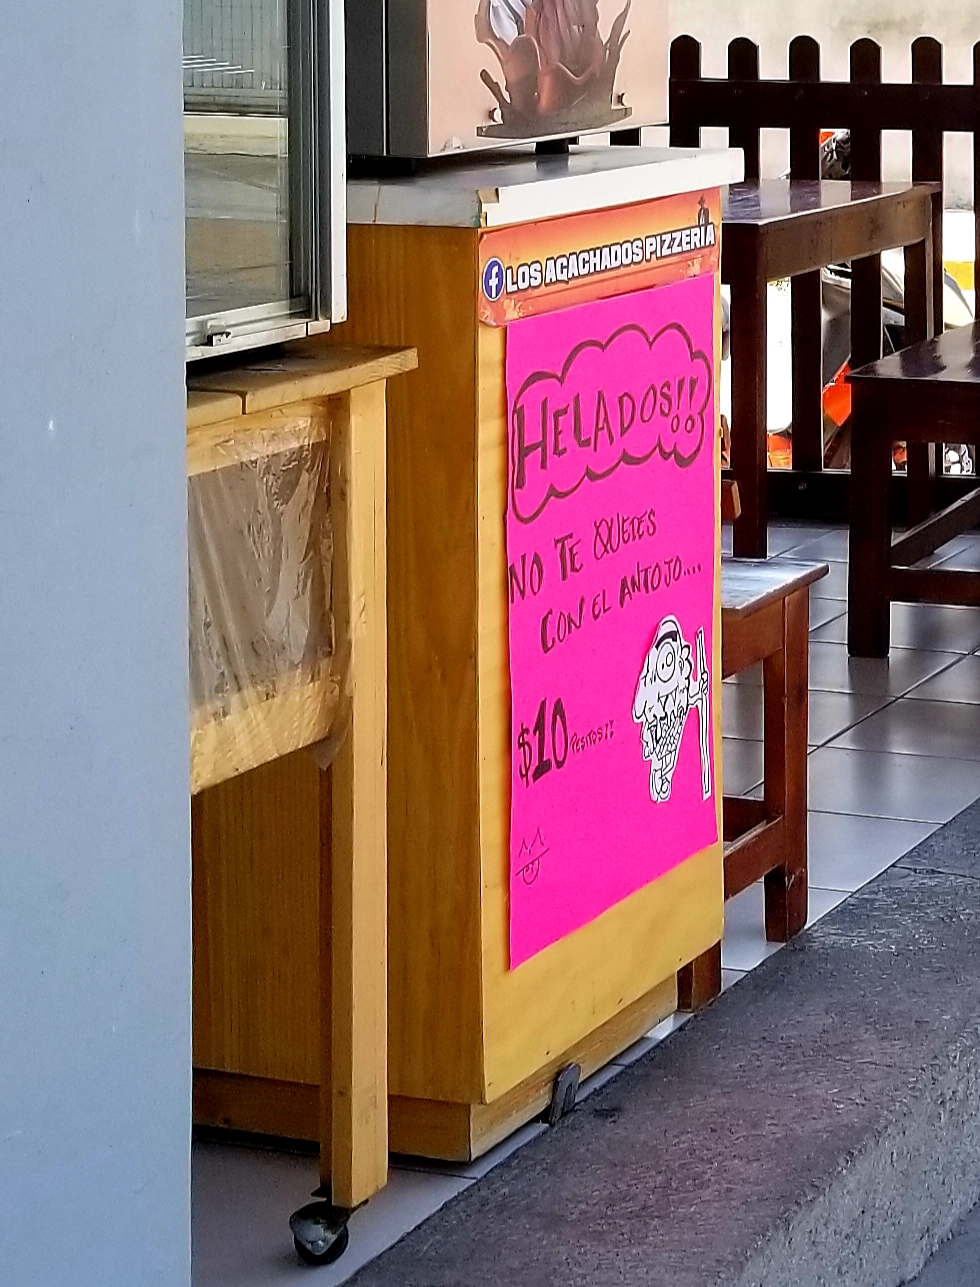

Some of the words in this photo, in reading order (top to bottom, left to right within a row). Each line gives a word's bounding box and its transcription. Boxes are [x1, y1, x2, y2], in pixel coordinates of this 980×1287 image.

[506, 264, 543, 295] LOS
[544, 239, 644, 284] AGACHADOS
[514, 376, 699, 491] HELADOS!!
[508, 551, 545, 605] NO
[553, 531, 585, 582] TE
[540, 595, 586, 655] CON
[591, 588, 613, 622] EL
[517, 696, 569, 789] $10
